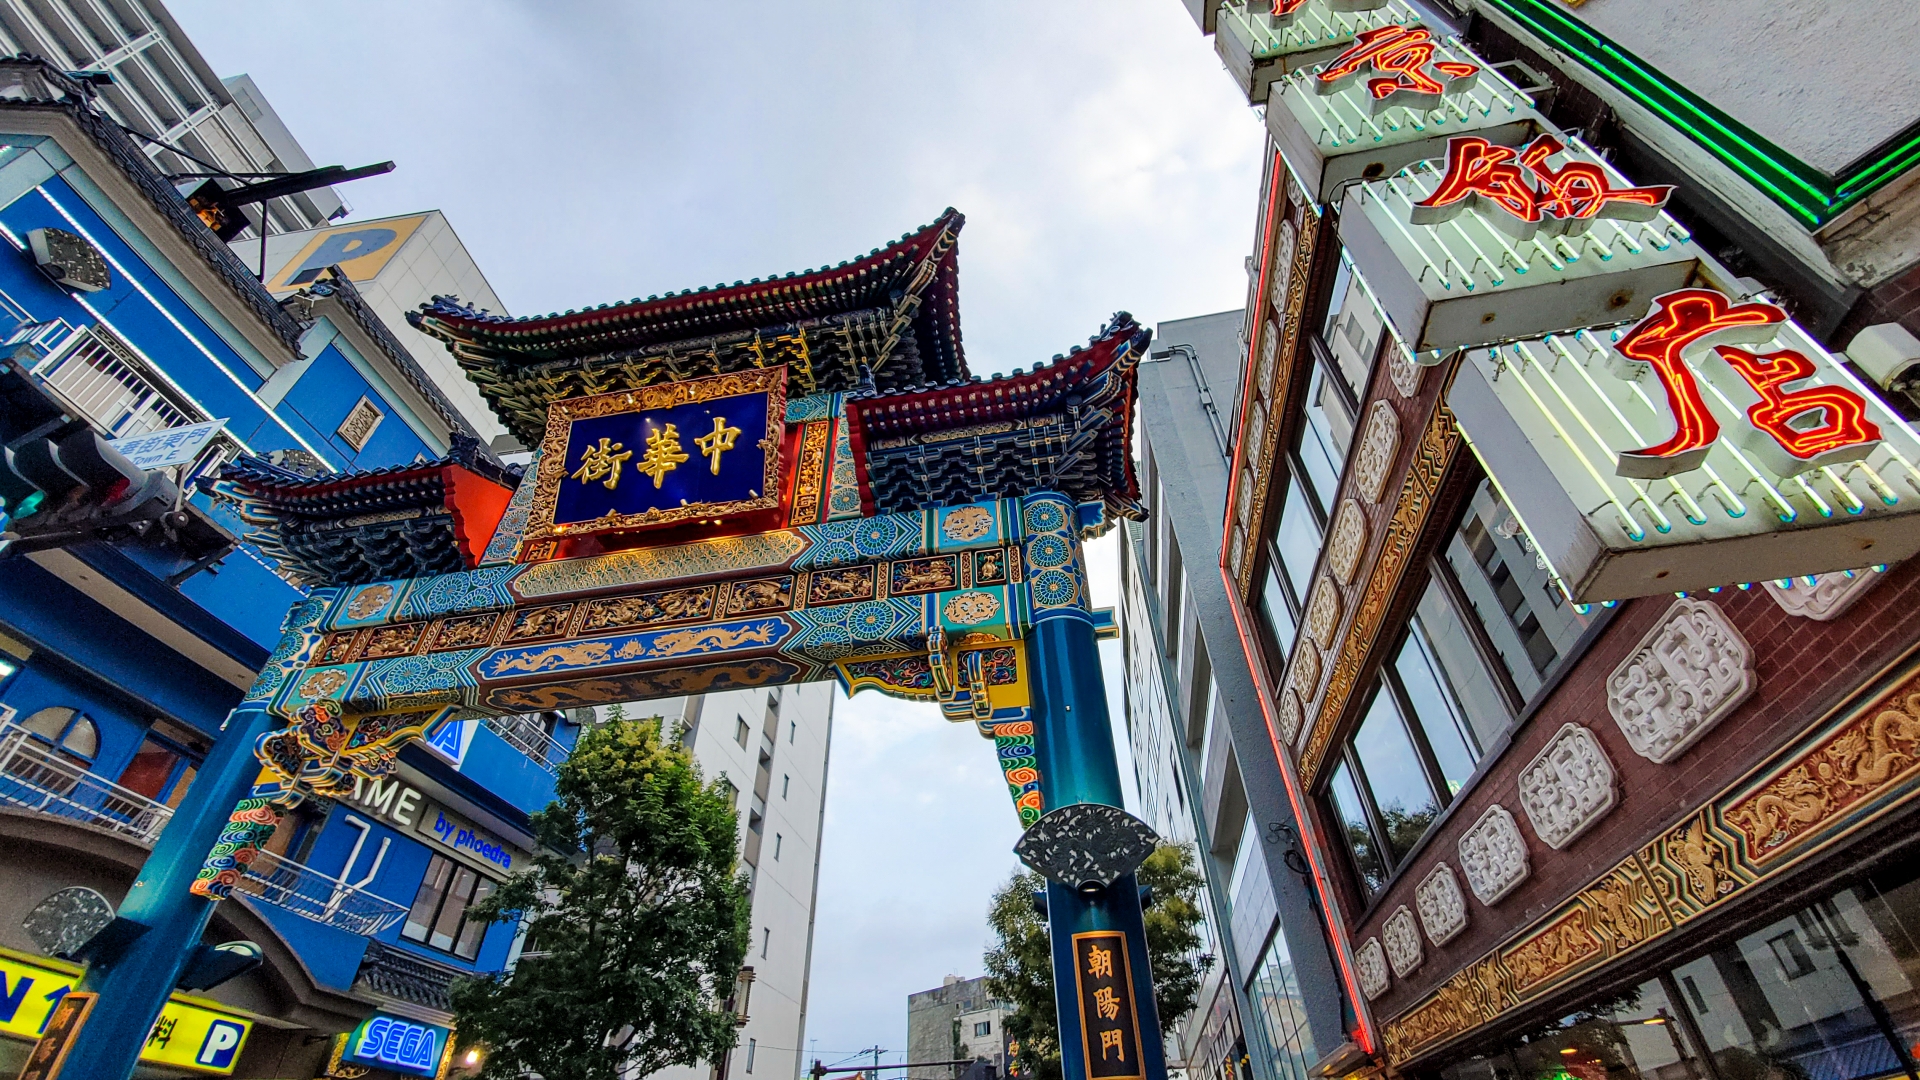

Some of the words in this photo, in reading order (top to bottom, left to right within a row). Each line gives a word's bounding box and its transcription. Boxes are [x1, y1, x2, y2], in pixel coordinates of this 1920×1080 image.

[281, 228, 398, 286] P
[433, 811, 456, 842] by
[454, 828, 513, 870] phoedra
[1088, 944, 1126, 1063] 朝陽門
[199, 1023, 239, 1064] P
[358, 1016, 436, 1070] SEGA
